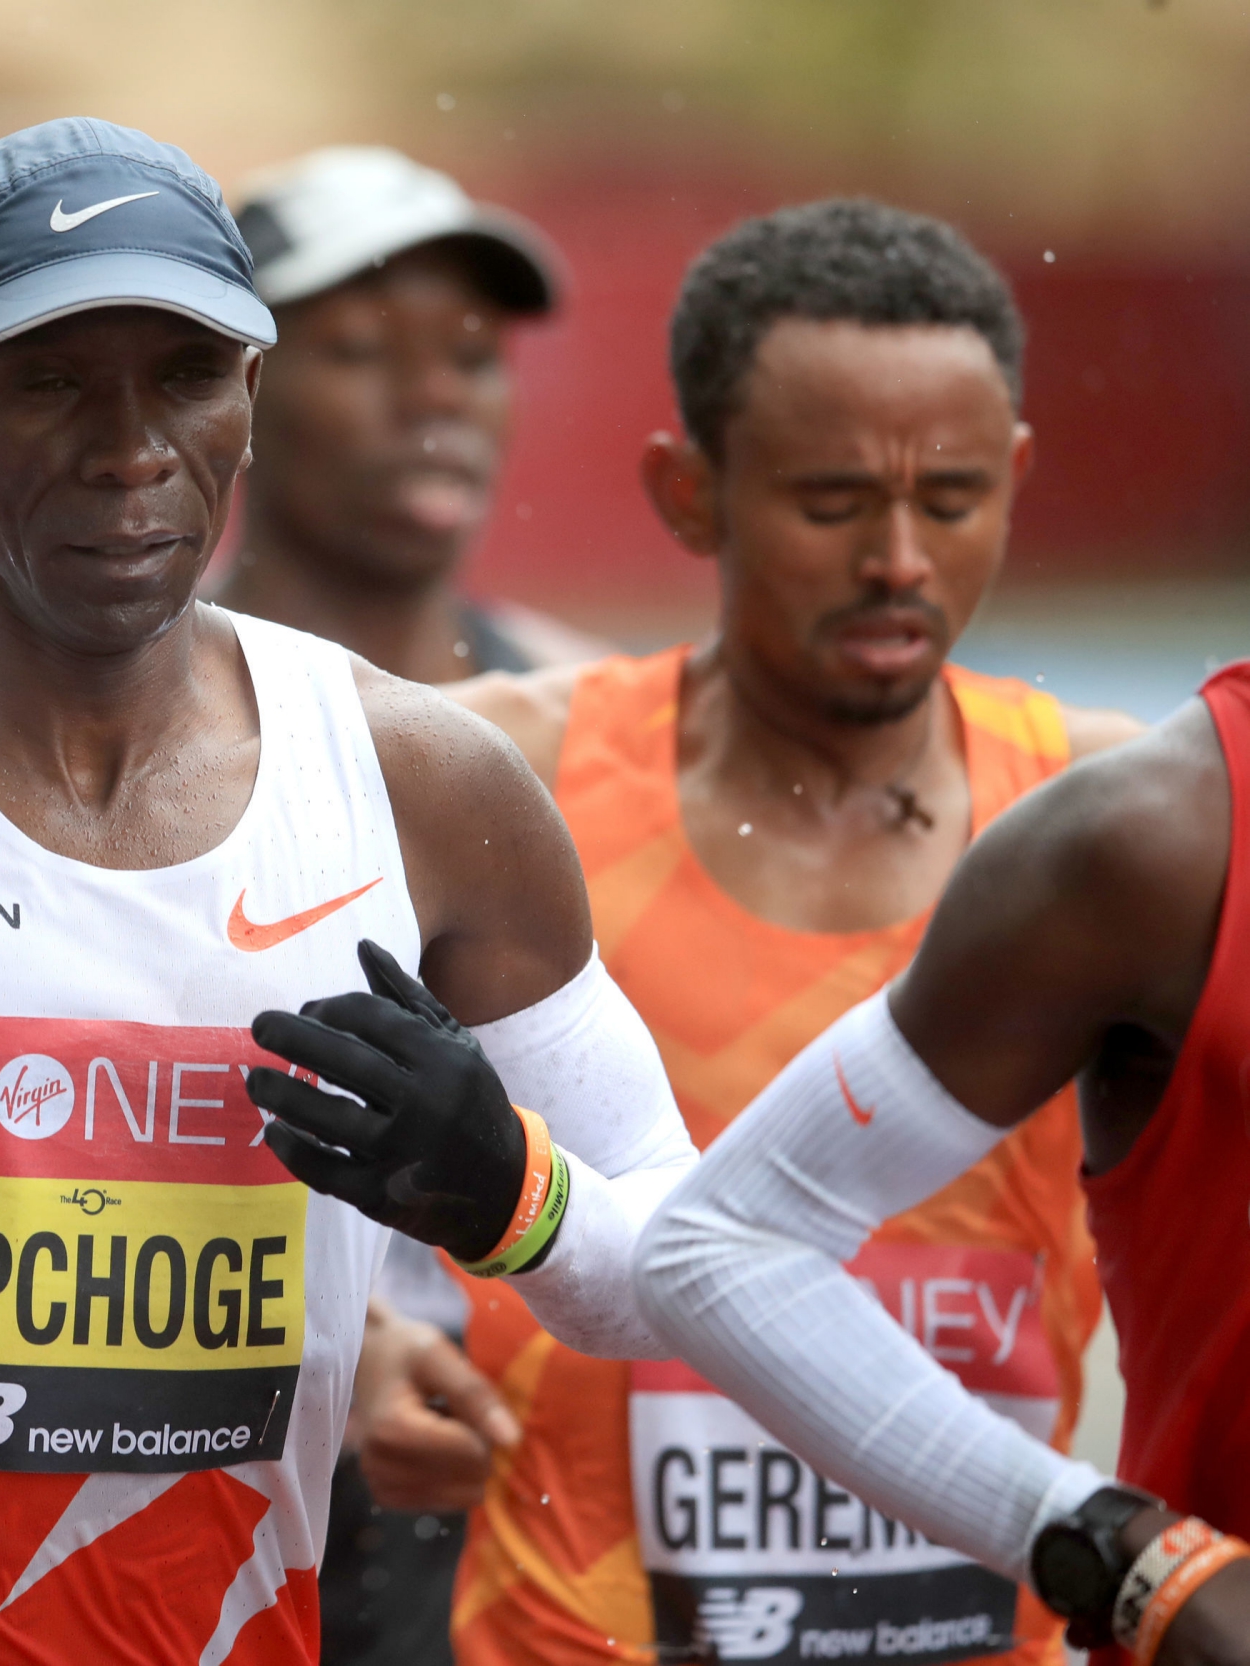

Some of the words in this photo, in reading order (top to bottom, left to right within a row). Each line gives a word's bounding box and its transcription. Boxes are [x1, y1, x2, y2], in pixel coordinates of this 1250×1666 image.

[0, 1065, 68, 1127] Virgin
[106, 1197, 122, 1205] Race
[28, 1427, 104, 1454] new
[111, 1422, 251, 1456] balance
[800, 1626, 873, 1658] new
